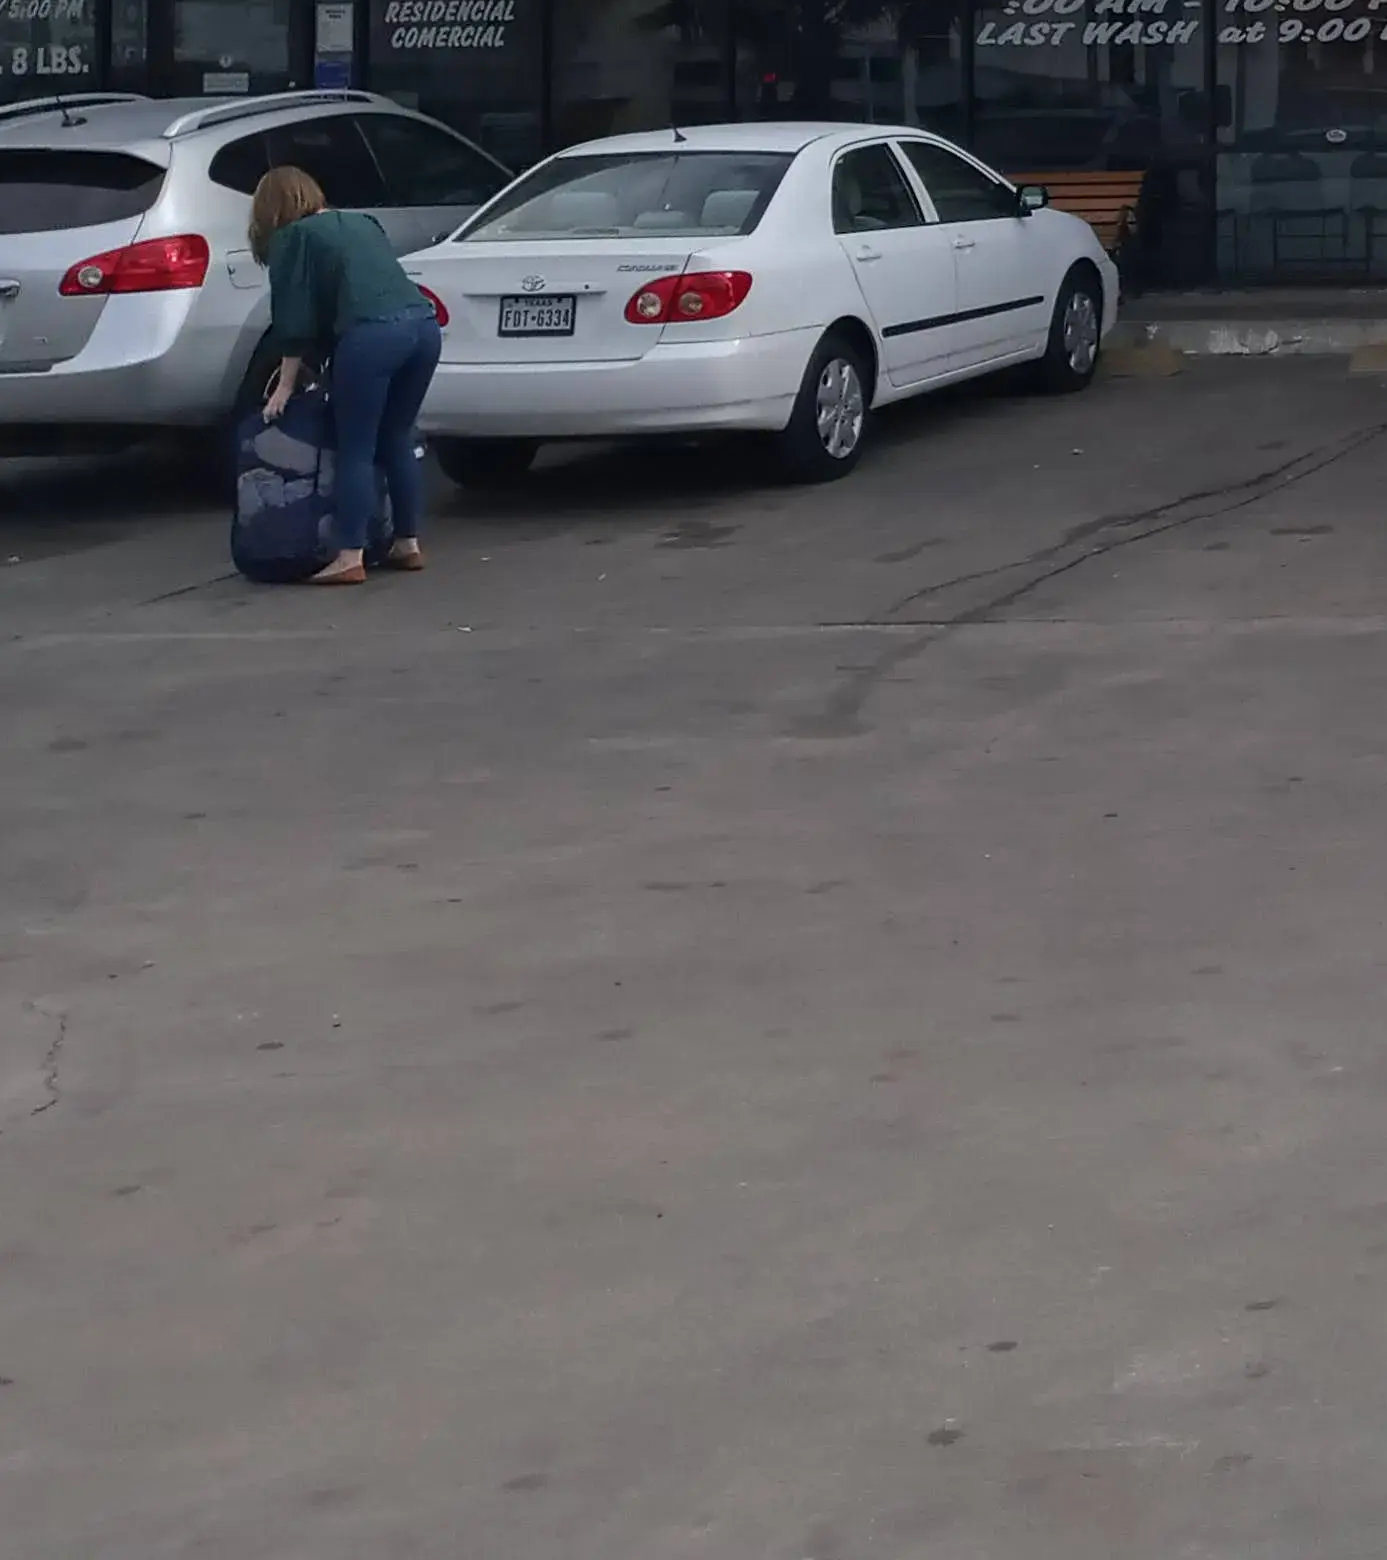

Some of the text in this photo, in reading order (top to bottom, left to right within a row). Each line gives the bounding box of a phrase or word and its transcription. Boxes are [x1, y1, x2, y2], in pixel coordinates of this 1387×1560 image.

[391, 26, 504, 49] COMERCIAL
[975, 22, 1076, 46] LAST
[1082, 20, 1200, 45] WASH
[1217, 22, 1266, 45] at
[1277, 18, 1372, 44] 9:00
[11, 45, 89, 76] 8 LBS.
